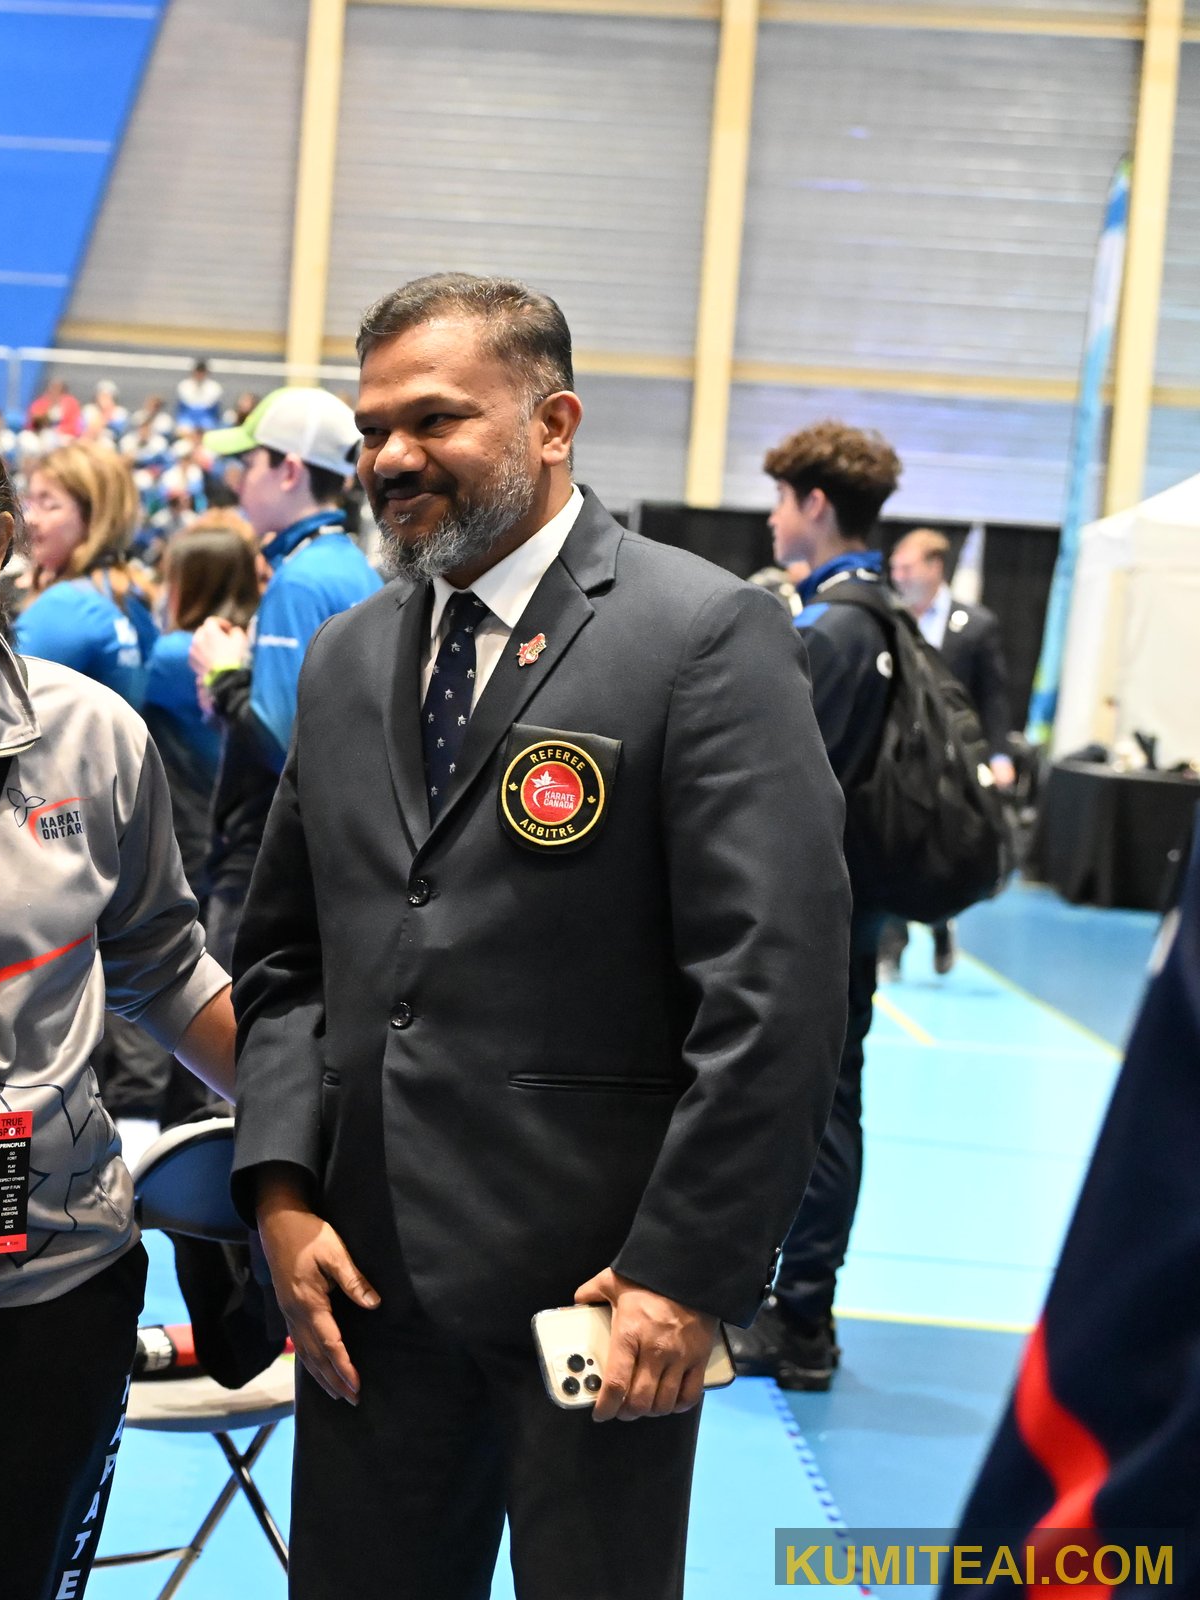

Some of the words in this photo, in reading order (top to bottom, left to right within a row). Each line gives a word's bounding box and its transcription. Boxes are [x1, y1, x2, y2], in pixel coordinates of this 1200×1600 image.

[529, 748, 586, 771] REFEREE
[544, 790, 576, 802] KARATE
[543, 799, 574, 810] CANADA
[40, 810, 80, 828] KARAT
[42, 823, 83, 840] ONTAR
[519, 818, 575, 838] ARBITRE
[1, 1117, 23, 1127] TRUE
[0, 1141, 26, 1149] PRINCIPLES
